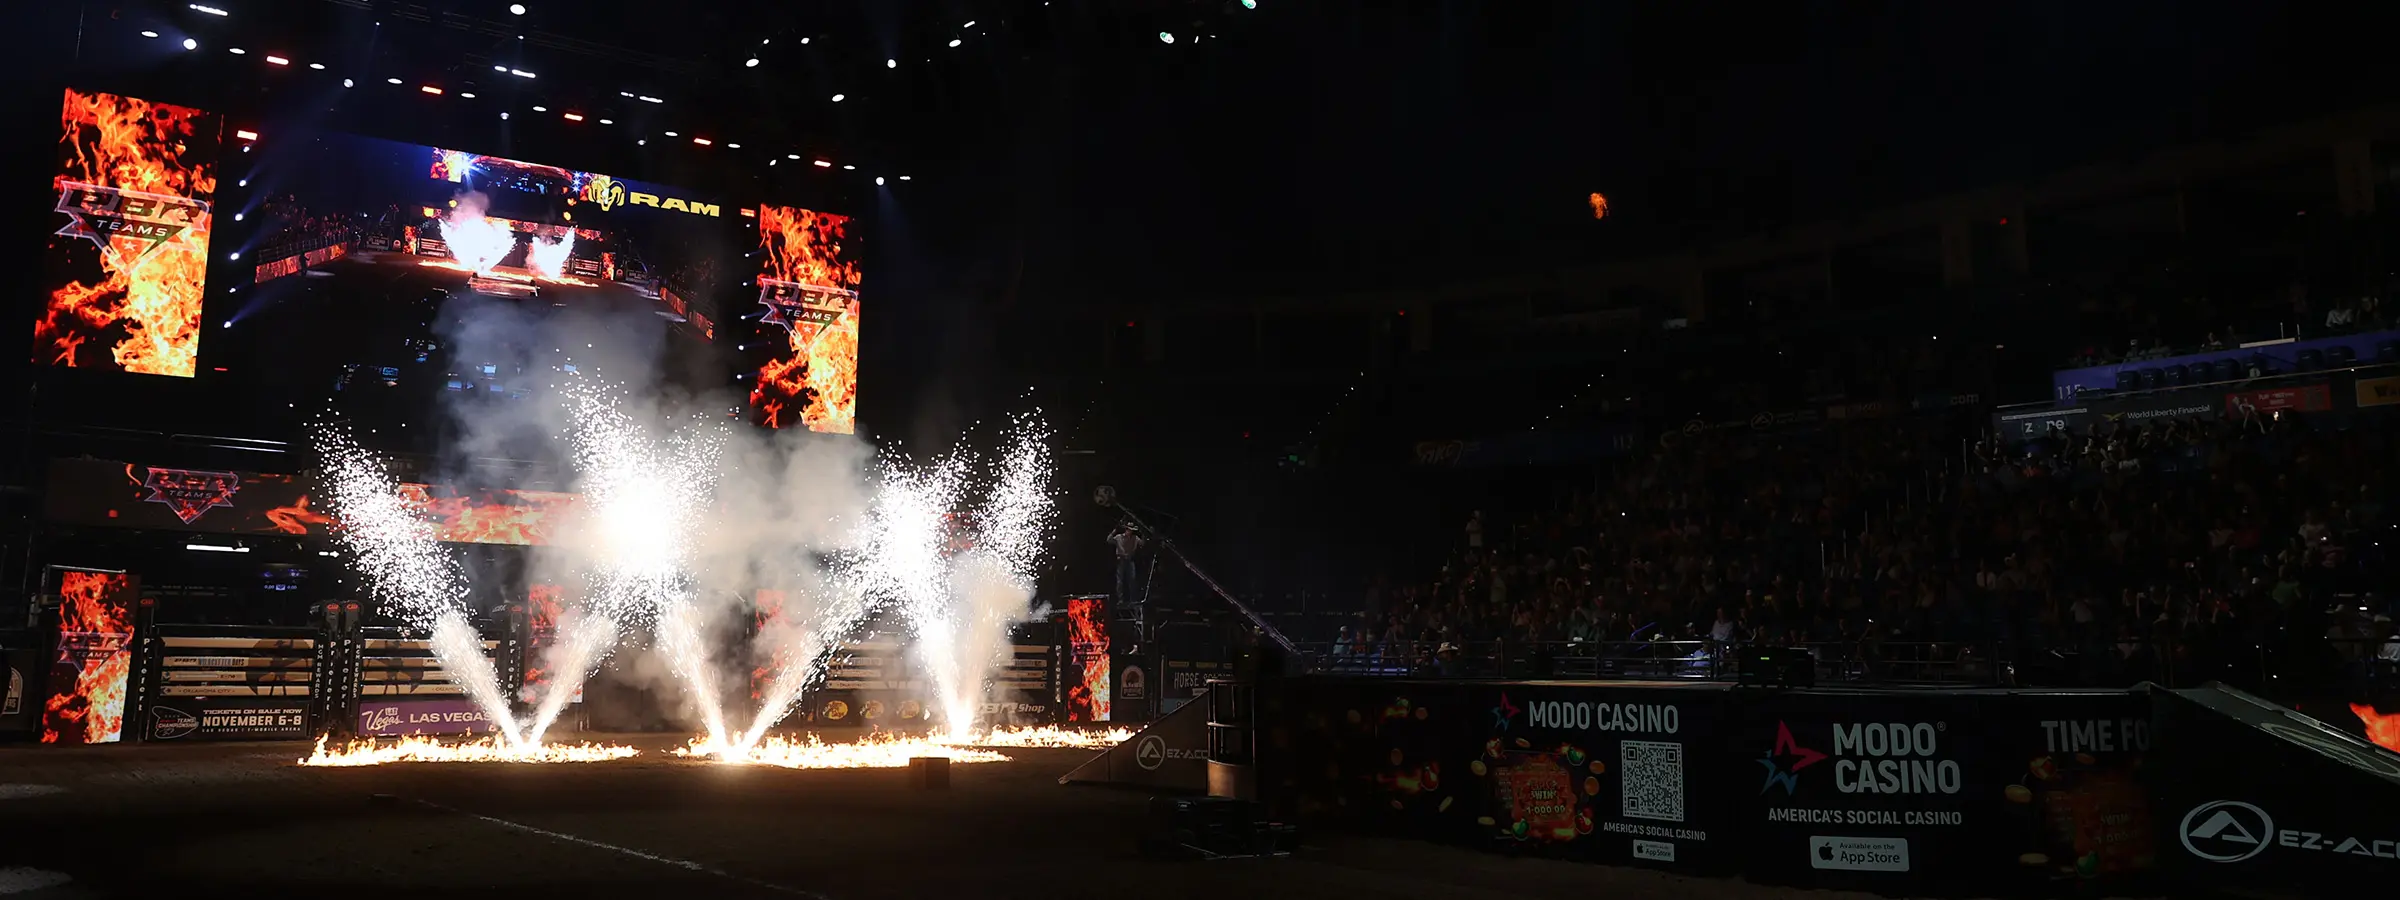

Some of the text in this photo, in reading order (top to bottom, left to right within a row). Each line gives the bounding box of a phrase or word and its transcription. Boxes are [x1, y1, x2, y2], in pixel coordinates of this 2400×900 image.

[629, 191, 720, 217] RAM
[96, 219, 168, 237] TEAMS
[785, 308, 832, 321] TEAMS
[2126, 404, 2210, 420] World Liberty Financial
[169, 490, 213, 498] TEAMS
[1173, 672, 1200, 690] HORSE
[1018, 703, 1045, 713] Shop
[202, 715, 302, 727] NOVEMBER 6-8
[361, 709, 404, 731] Vegas
[409, 711, 493, 724] LAS VEGAS
[1597, 702, 1680, 734] CASINO
[2040, 719, 2115, 753] TIME
[1834, 759, 1962, 795] CASINO
[1768, 807, 1962, 826] AMERICA'S SOCIAL CASINO
[1603, 822, 1706, 841] AMERICA'S SOCIAL CASINO
[1645, 848, 1671, 858] App Store
[1839, 842, 1871, 850] Available
[1883, 843, 1896, 851] the
[1840, 851, 1900, 864] App Store
